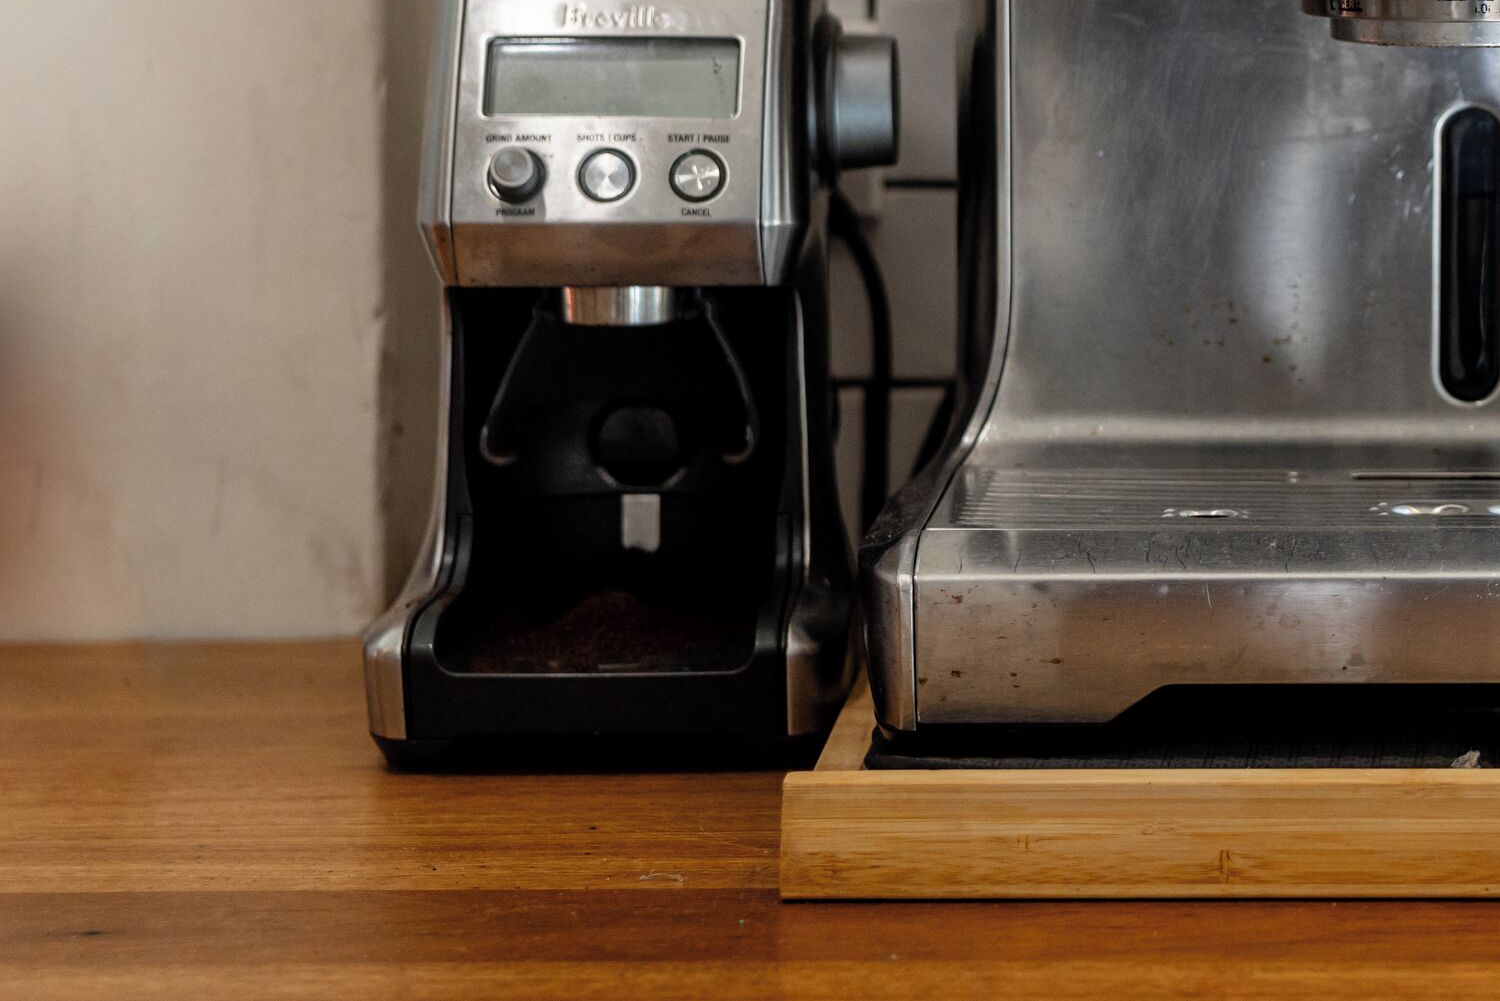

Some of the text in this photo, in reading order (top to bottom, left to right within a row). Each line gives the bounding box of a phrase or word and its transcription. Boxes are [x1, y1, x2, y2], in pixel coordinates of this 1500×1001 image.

[559, 4, 673, 27] Breville
[485, 133, 552, 143] GRIND AMOUNT
[576, 132, 605, 142] SHOTS
[613, 132, 637, 142] CUPS
[667, 133, 694, 143] START
[703, 133, 730, 143] PAUSE
[496, 207, 536, 217] PROGRAM
[681, 207, 712, 217] CANCEL
